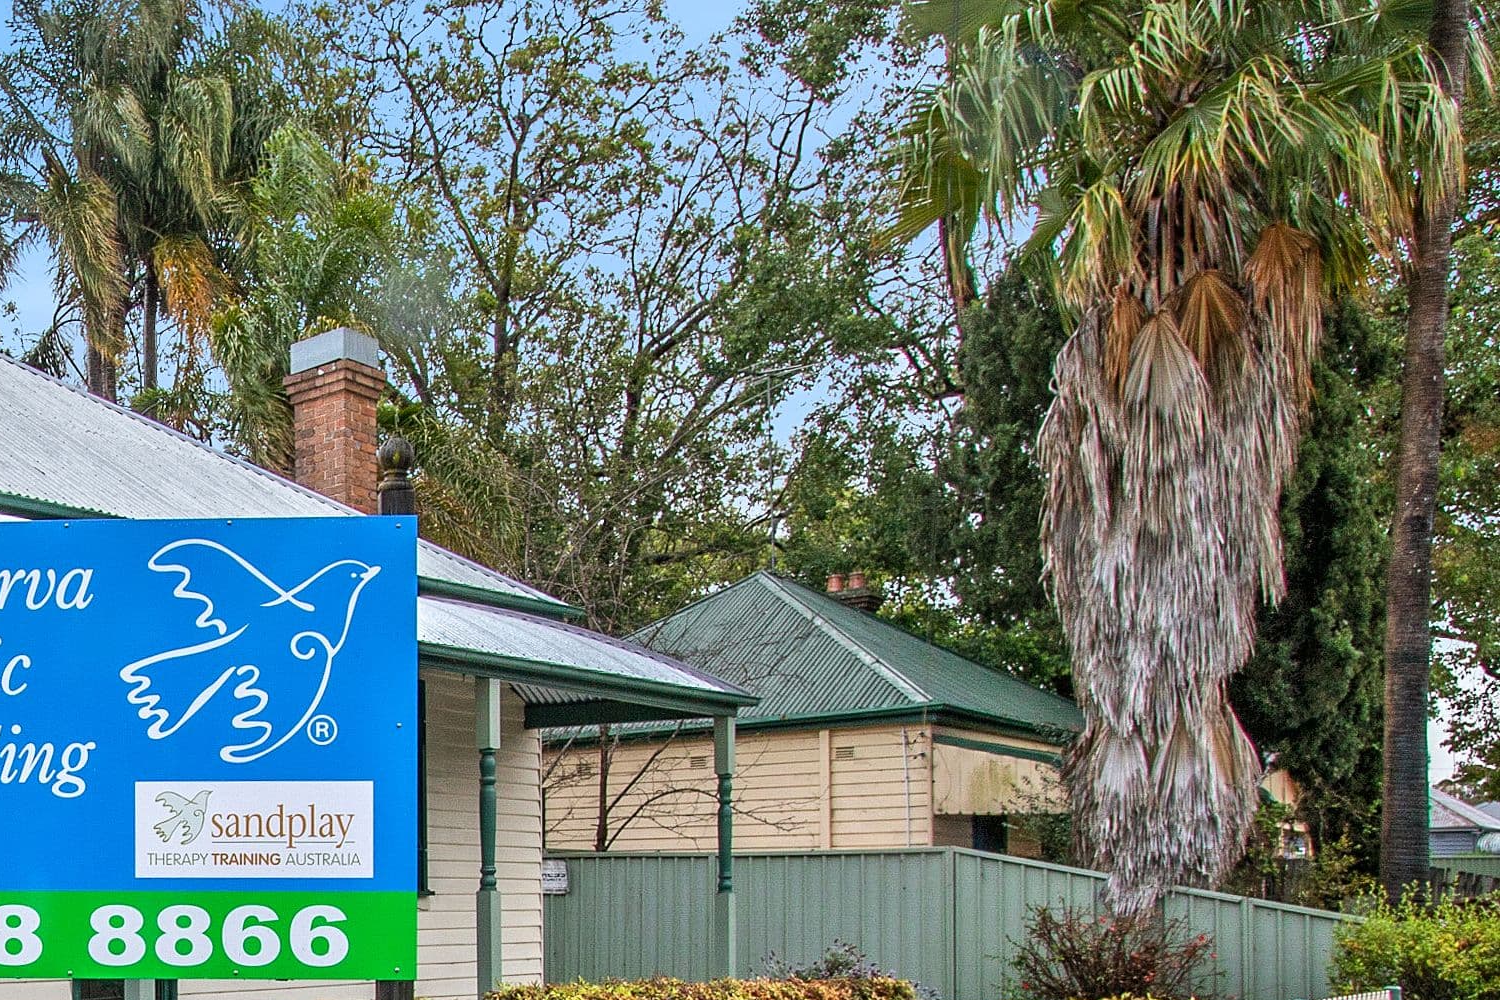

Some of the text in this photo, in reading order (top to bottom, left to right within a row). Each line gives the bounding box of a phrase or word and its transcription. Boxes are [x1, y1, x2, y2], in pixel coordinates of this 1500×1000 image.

[211, 803, 355, 849] sandplay
[147, 852, 361, 866] THERAPY TRAINING AUSTRALIA
[87, 904, 350, 967] 8866
